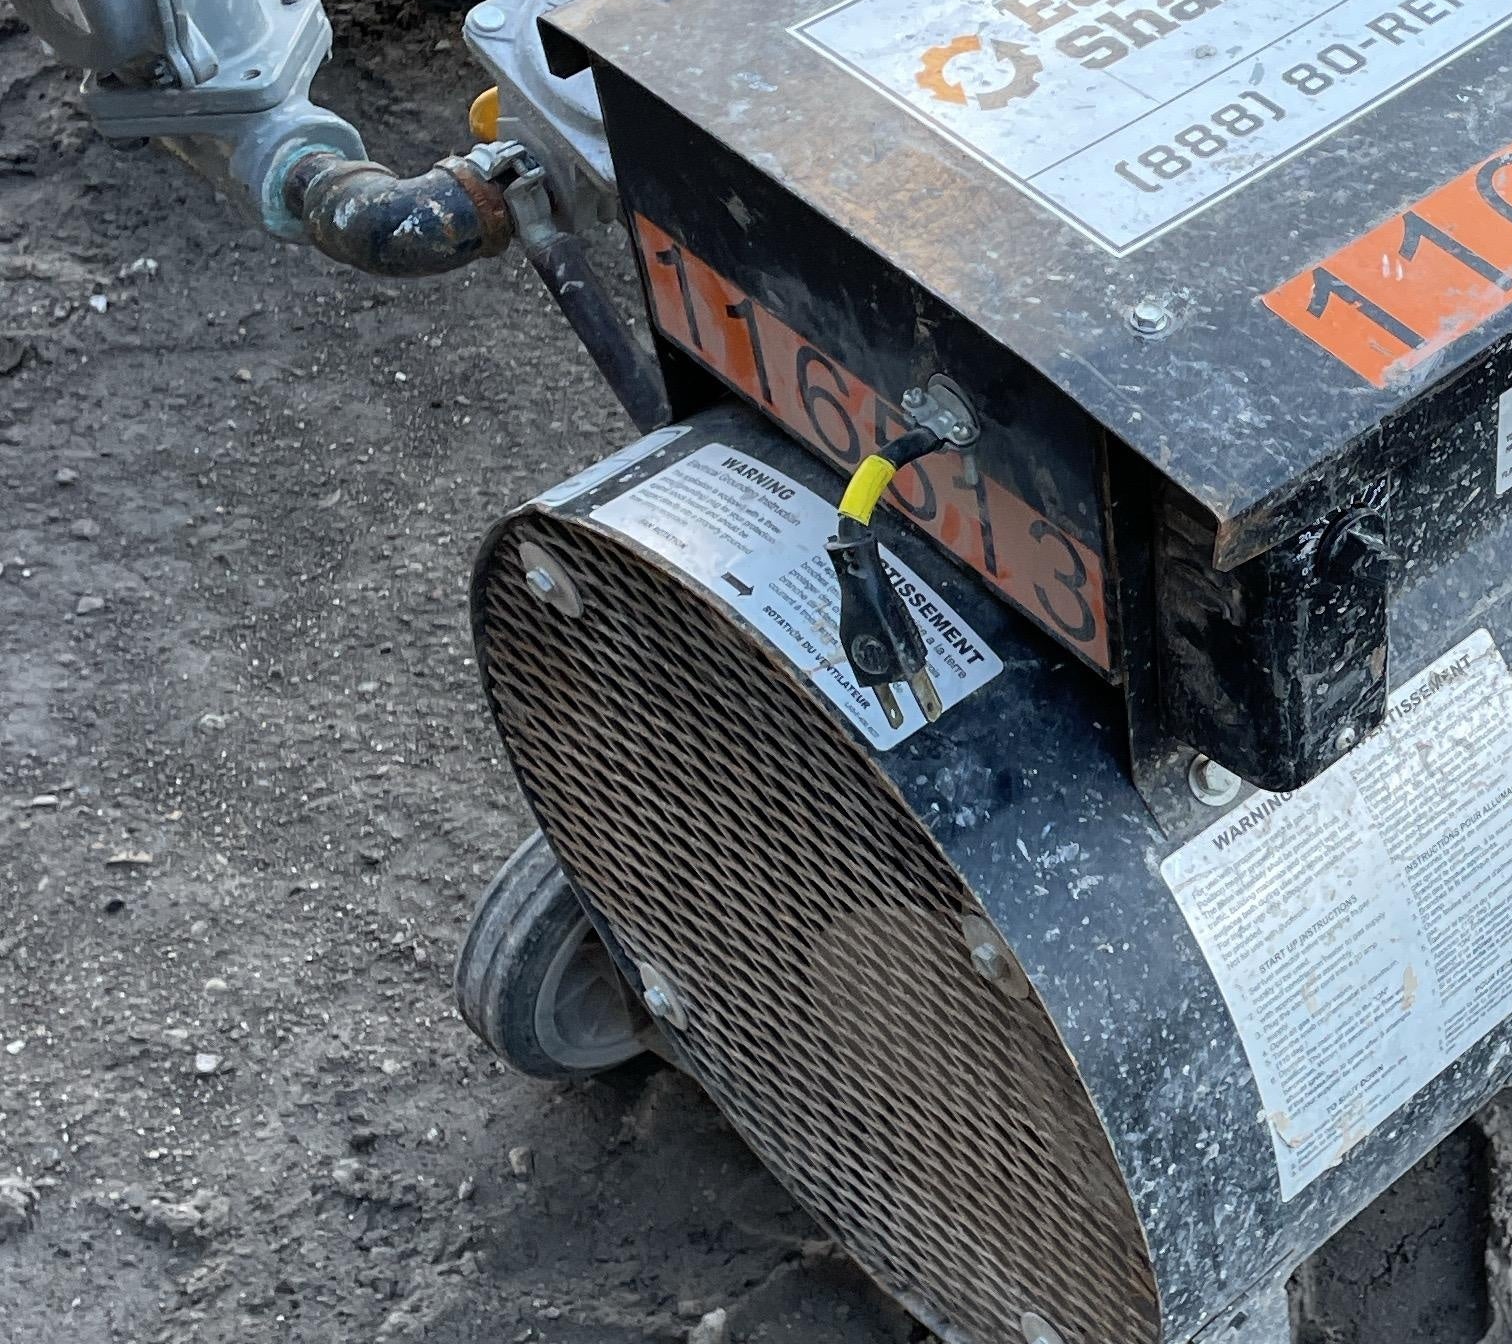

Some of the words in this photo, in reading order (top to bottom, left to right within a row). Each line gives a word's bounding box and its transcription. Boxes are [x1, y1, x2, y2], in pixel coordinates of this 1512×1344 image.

[1114, 89, 1287, 193] (888)
[656, 244, 1097, 644] 116513
[721, 457, 795, 501] WARNING
[801, 640, 817, 654] DU
[815, 653, 871, 709] VENTILATEUR
[1212, 790, 1294, 851] WARNING
[1459, 809, 1481, 831] POUR
